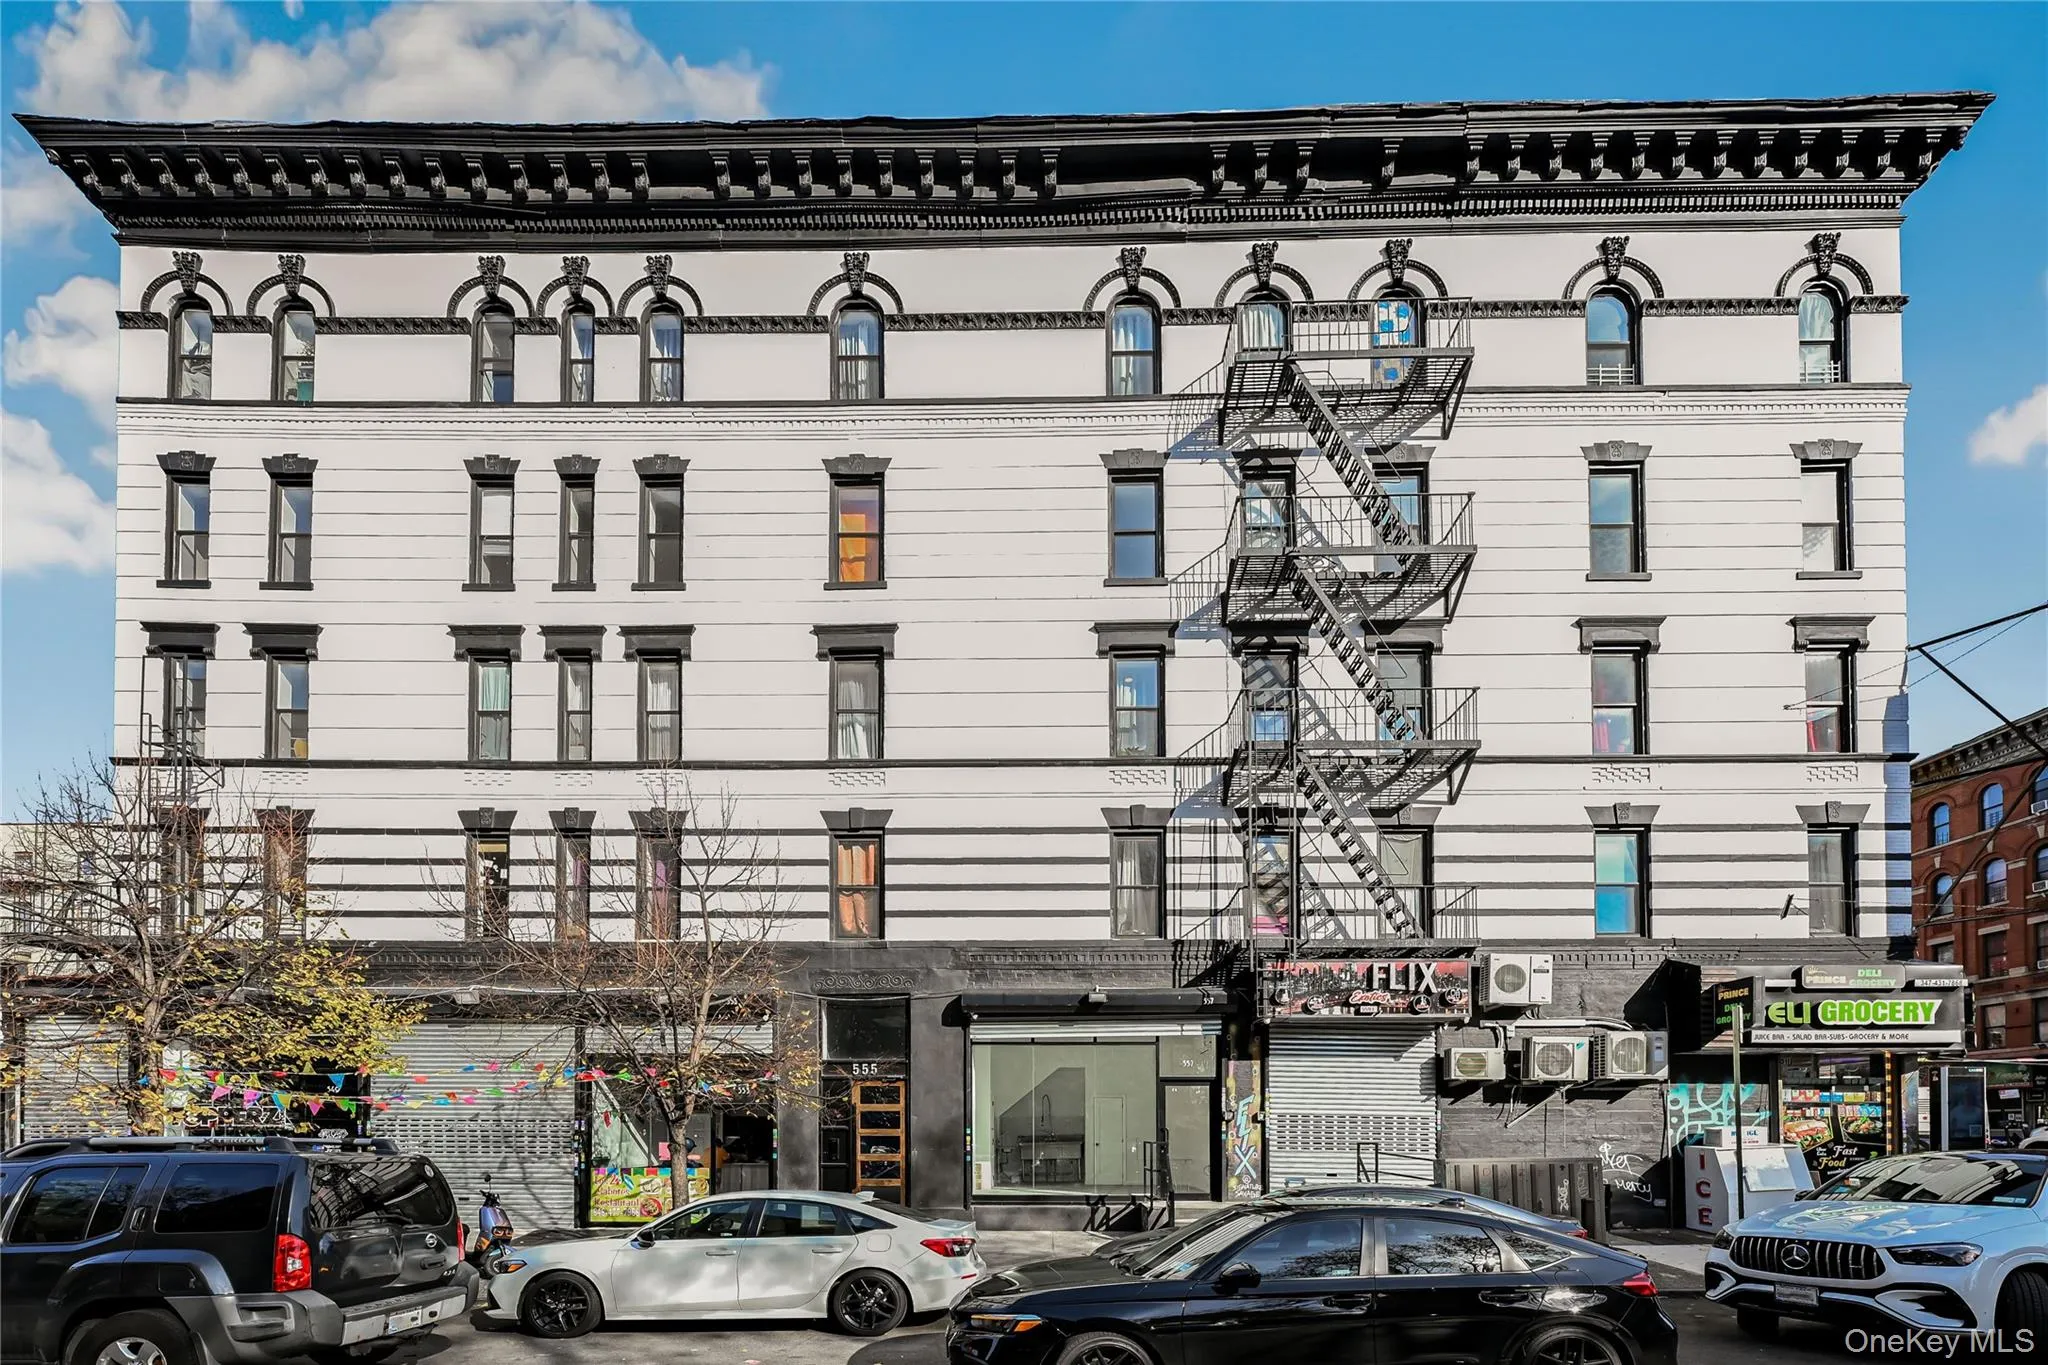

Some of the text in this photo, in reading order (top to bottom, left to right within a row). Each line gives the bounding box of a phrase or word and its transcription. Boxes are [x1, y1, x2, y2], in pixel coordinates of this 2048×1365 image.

[1372, 962, 1438, 993] FLIX
[1806, 976, 1847, 984] PRINCE
[1849, 979, 1897, 987] GROCERY
[1718, 987, 1749, 1000] PRINCE
[1767, 1000, 1938, 1024] ELI GROCERY
[852, 1063, 878, 1075] 555
[1832, 1145, 1858, 1158] Fast
[1818, 1156, 1847, 1169] Food
[1696, 1152, 1713, 1226] ICE
